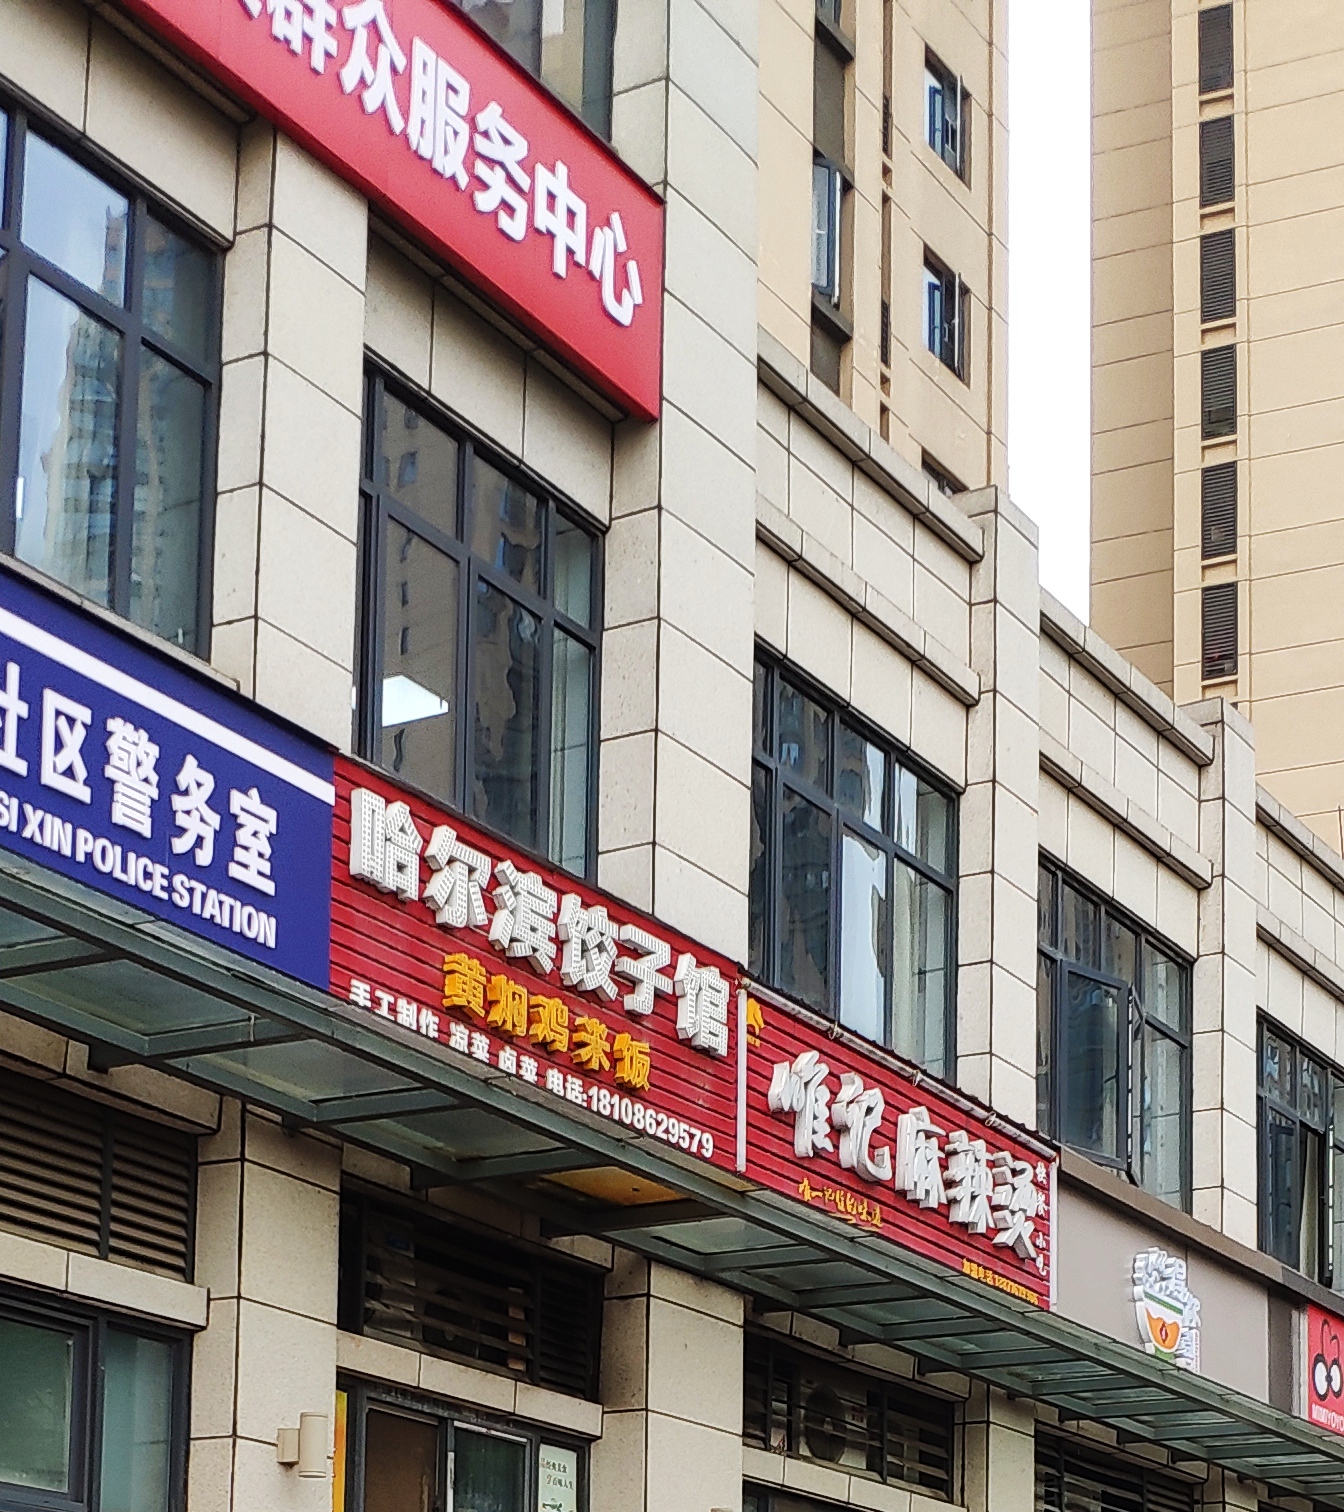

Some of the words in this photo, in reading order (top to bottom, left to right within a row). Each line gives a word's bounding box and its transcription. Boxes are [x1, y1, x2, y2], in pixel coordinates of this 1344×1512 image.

[240, 0, 643, 327] 群众服务中心
[22, 812, 75, 863] XIN
[76, 820, 169, 901] POLICE
[172, 878, 278, 950] STATION
[350, 786, 730, 1058] 哈尔滨饺子馆
[350, 979, 439, 1040] 手工制作
[498, 1046, 539, 1084] 卤菜
[443, 952, 652, 1091] 黄焖鸡米饭
